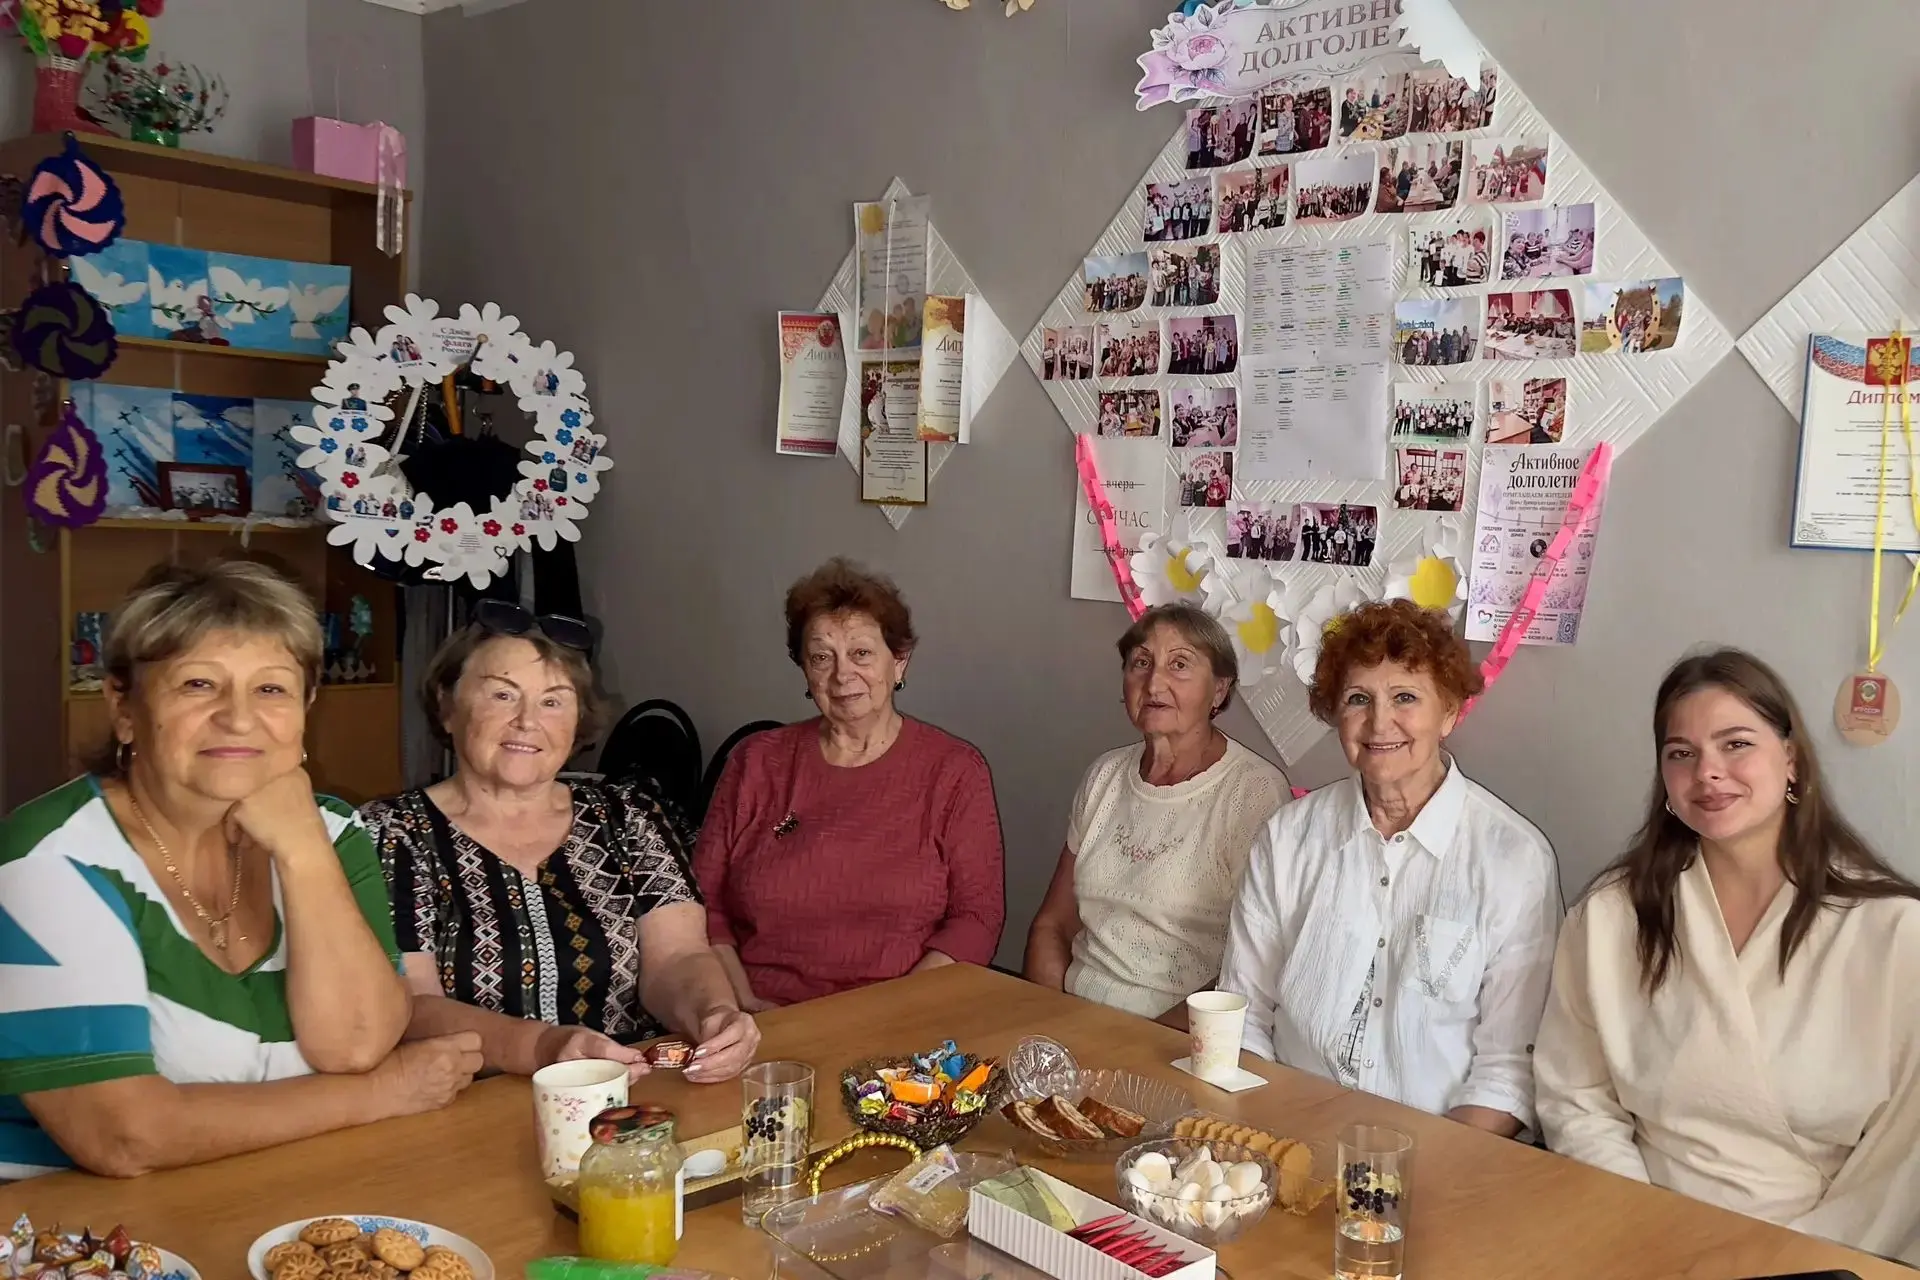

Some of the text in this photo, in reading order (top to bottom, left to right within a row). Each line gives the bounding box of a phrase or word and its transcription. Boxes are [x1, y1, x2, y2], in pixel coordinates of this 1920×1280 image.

[1238, 25, 1408, 76] ДОЛГОЛЕ
[1509, 453, 1579, 473] Активное
[1106, 480, 1134, 492] вчера
